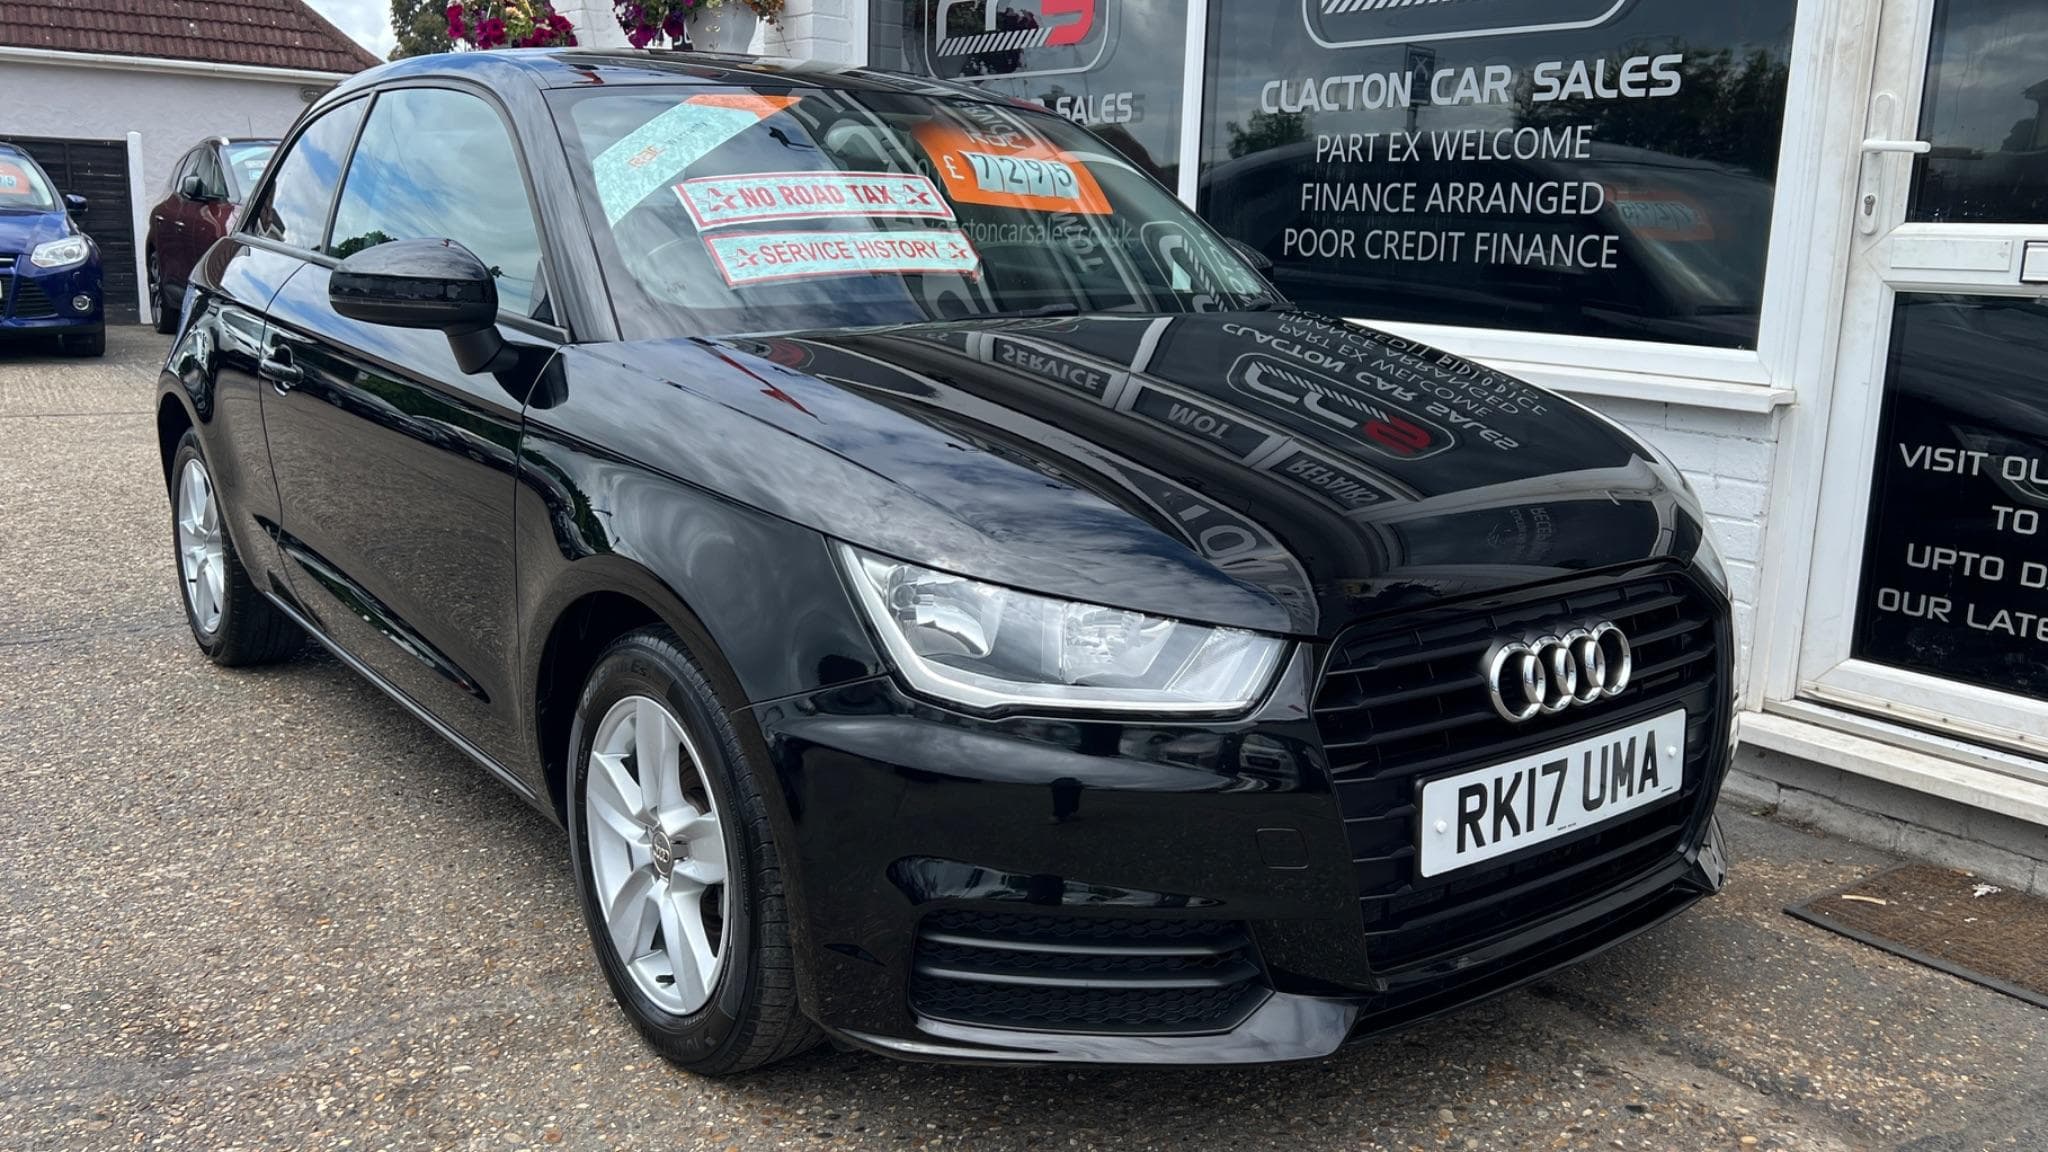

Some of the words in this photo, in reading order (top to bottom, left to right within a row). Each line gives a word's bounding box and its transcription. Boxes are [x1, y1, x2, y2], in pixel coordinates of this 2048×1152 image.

[1261, 71, 1412, 115] CLACTON
[1431, 64, 1513, 107] CAR
[1532, 53, 1683, 102] SALES
[1056, 91, 1133, 124] SALES
[1316, 133, 1380, 163] PART
[1387, 131, 1420, 162] EX
[1432, 125, 1592, 161] WELCOME
[738, 187, 777, 208] NO
[781, 184, 846, 207] ROAD
[845, 184, 896, 205] TAX
[1300, 182, 1417, 213] FINANCE
[1424, 181, 1605, 215] ARRANGED
[758, 240, 857, 265] SERVICE
[857, 239, 940, 260] HISTORY
[1283, 228, 1355, 259] POOR
[1364, 229, 1466, 264] CREDIT
[1474, 232, 1620, 270] FINANCE
[1899, 443, 1989, 476] VISIT
[1992, 505, 2039, 535] TO
[1906, 543, 2004, 581] UPTO
[2020, 561, 2048, 590] D
[1877, 587, 1952, 623] OUR
[1456, 757, 1568, 854] RK17
[1583, 730, 1659, 812] UMA
